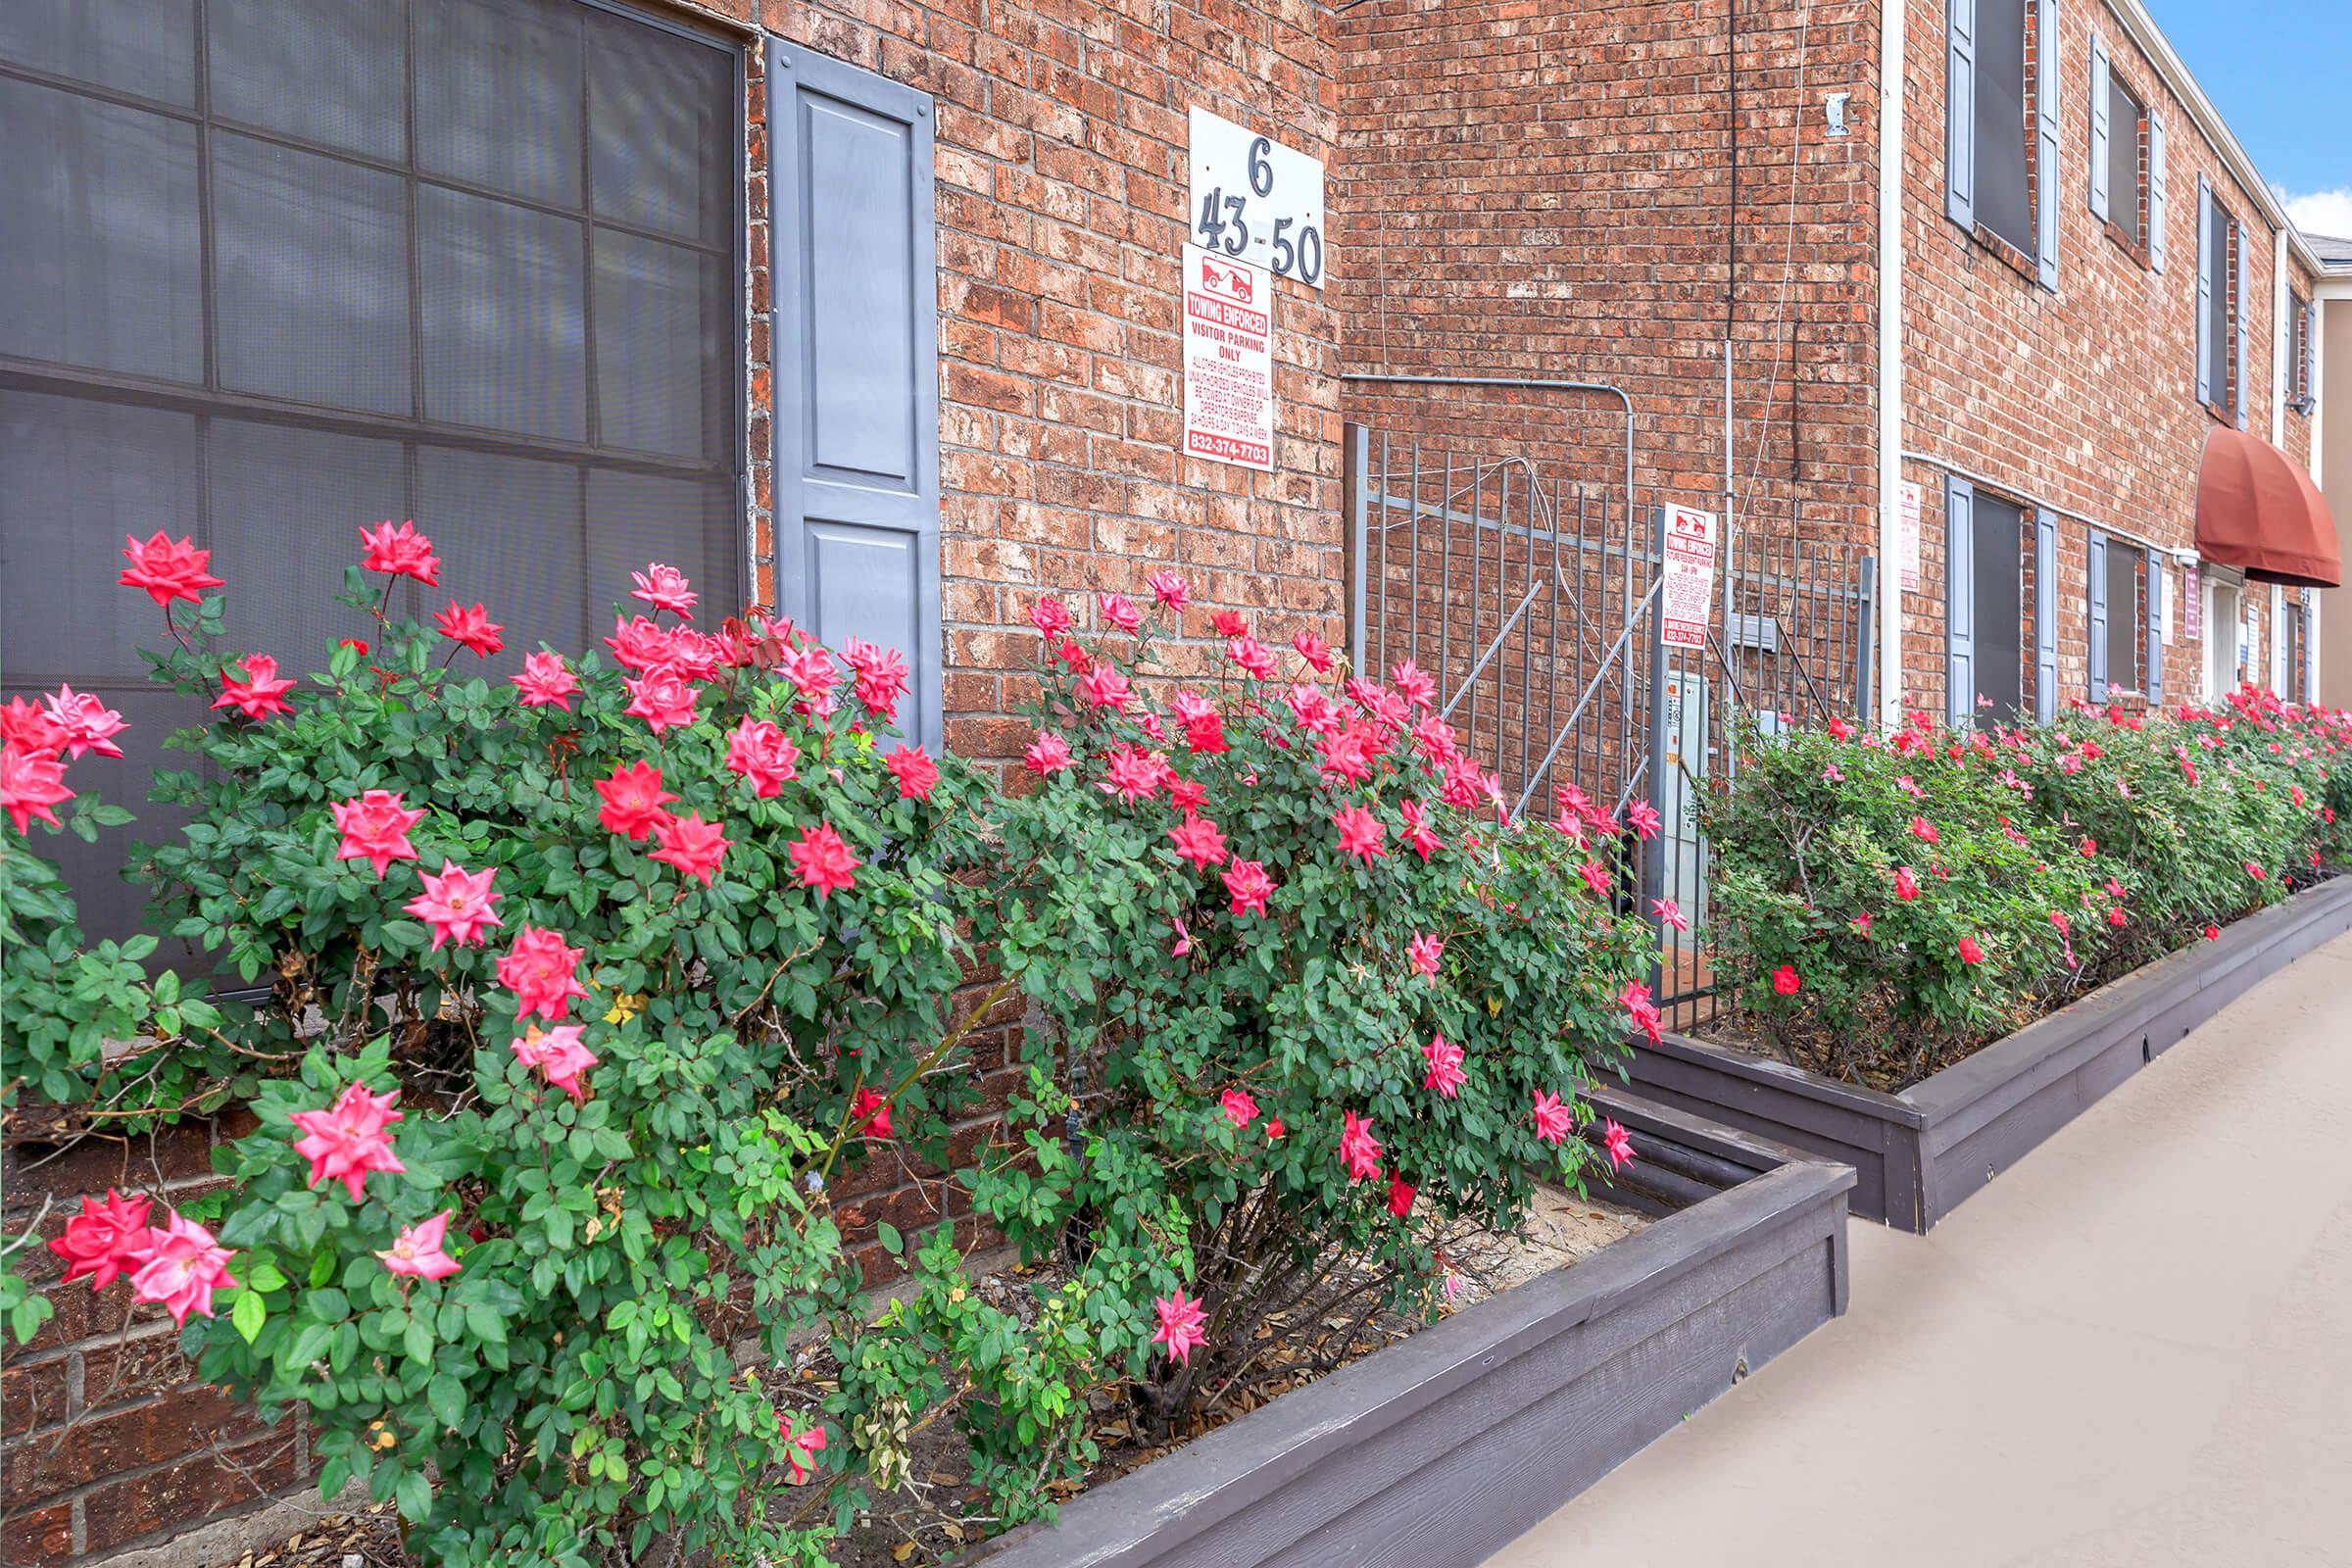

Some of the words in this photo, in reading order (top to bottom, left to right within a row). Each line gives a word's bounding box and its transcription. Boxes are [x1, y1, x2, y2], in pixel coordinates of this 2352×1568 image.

[1249, 137, 1273, 198] 6
[1190, 295, 1222, 322] TOWING
[1223, 305, 1266, 334] ENFORCED
[1192, 321, 1226, 342] VISITOR
[1228, 332, 1265, 354] PARKING
[1218, 345, 1241, 363] ONLY
[1188, 368, 1230, 390] UNAUTHORIZED
[1230, 381, 1255, 398] VEHICLES
[1254, 387, 1269, 401] WILL
[1203, 386, 1222, 403] TOWED
[1191, 433, 1267, 462] 832-374-7703
